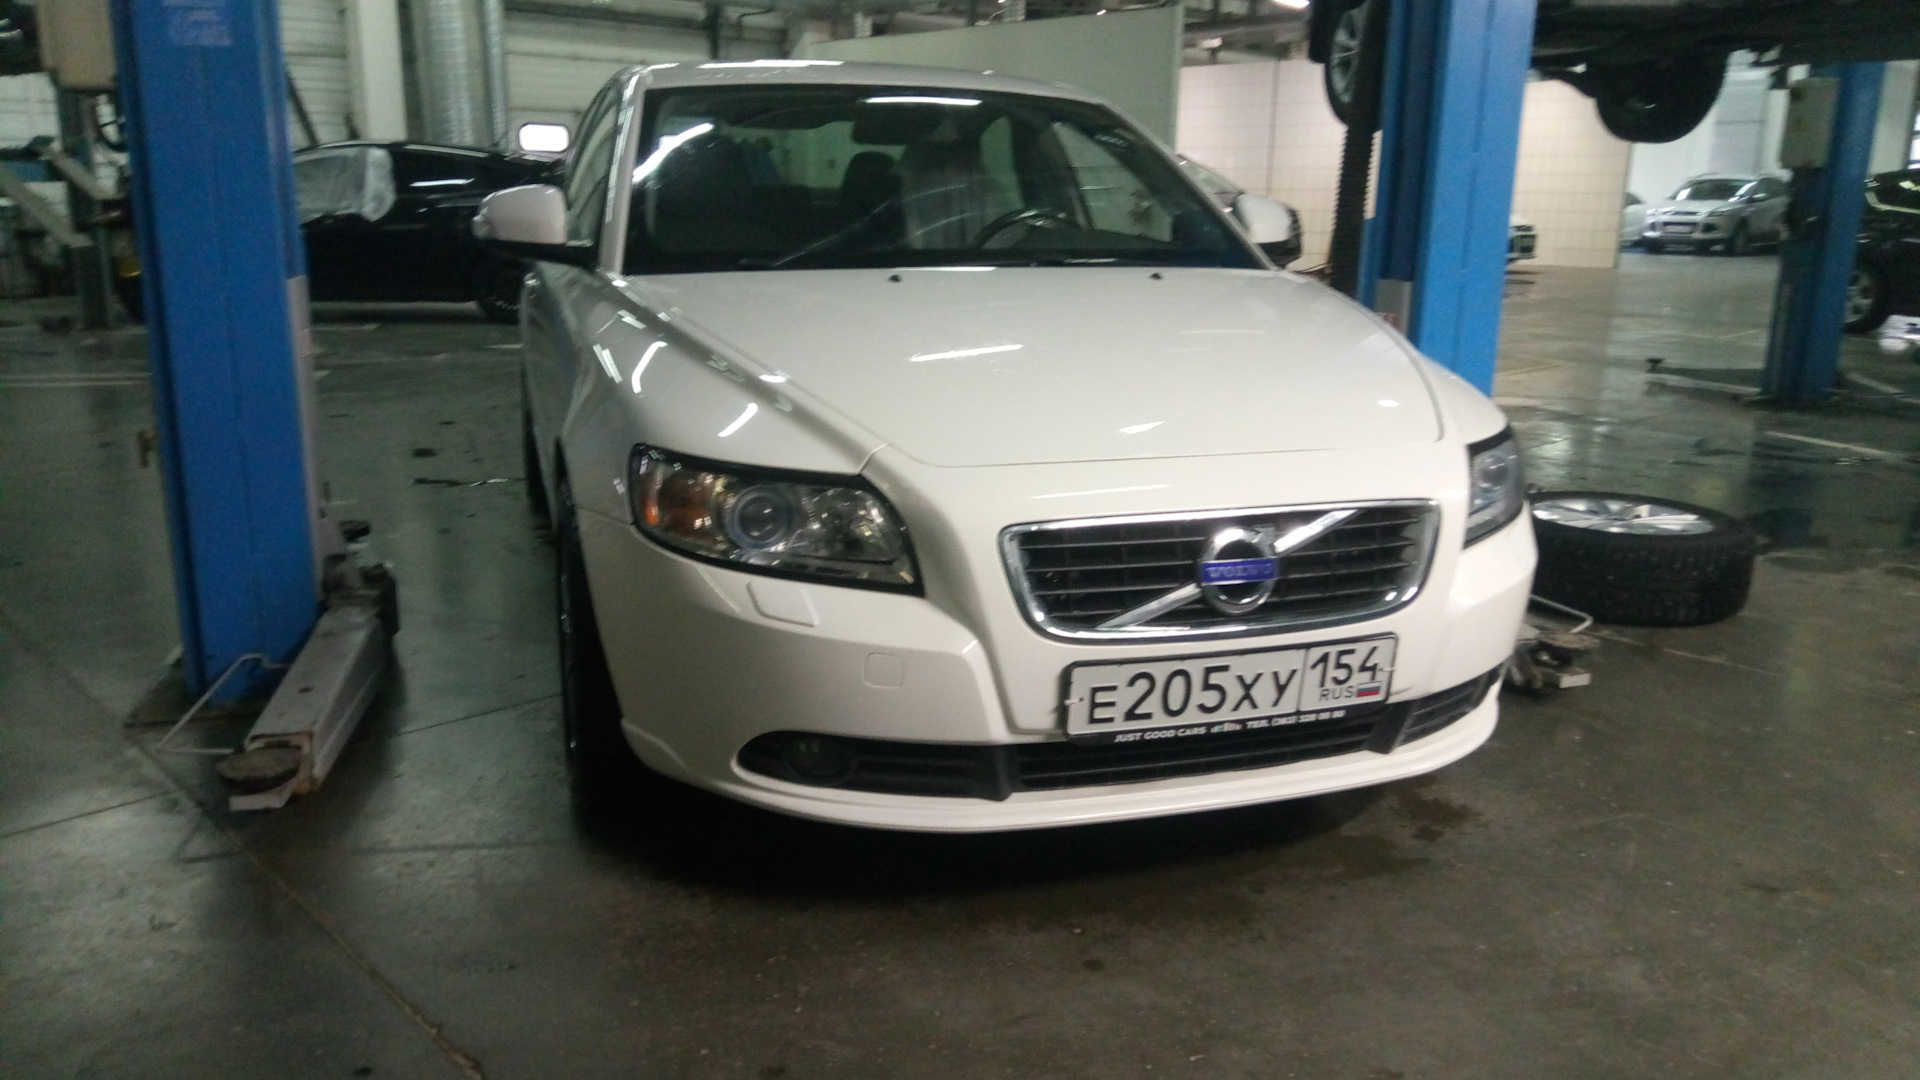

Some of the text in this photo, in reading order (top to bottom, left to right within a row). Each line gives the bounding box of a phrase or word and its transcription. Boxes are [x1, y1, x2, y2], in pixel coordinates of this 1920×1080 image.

[1309, 646, 1378, 688] 154
[1319, 685, 1355, 701] RUS
[1113, 726, 1207, 743] JUST GOOD CARS
